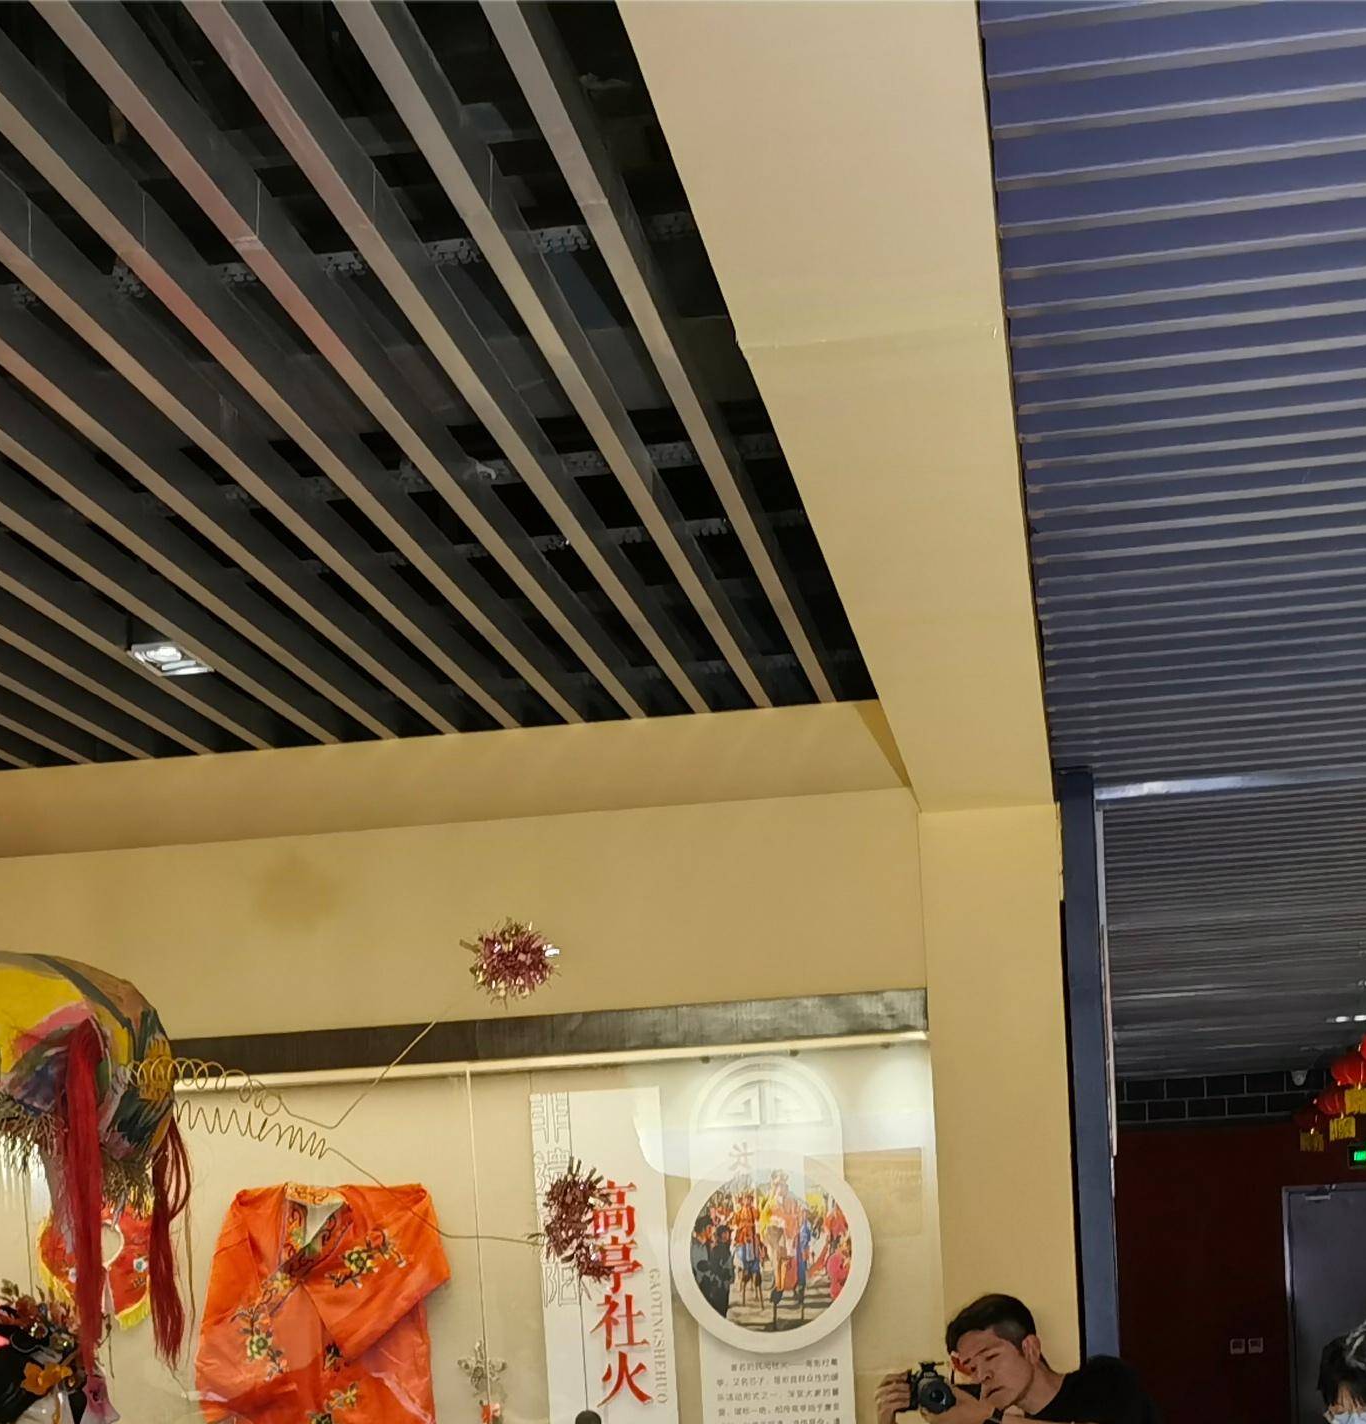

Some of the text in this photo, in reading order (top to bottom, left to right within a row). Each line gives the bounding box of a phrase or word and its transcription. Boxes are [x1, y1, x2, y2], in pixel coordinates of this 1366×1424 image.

[590, 1179, 654, 1408] 高亭社火
[648, 1268, 669, 1405] GAOTINGSHEHUO
